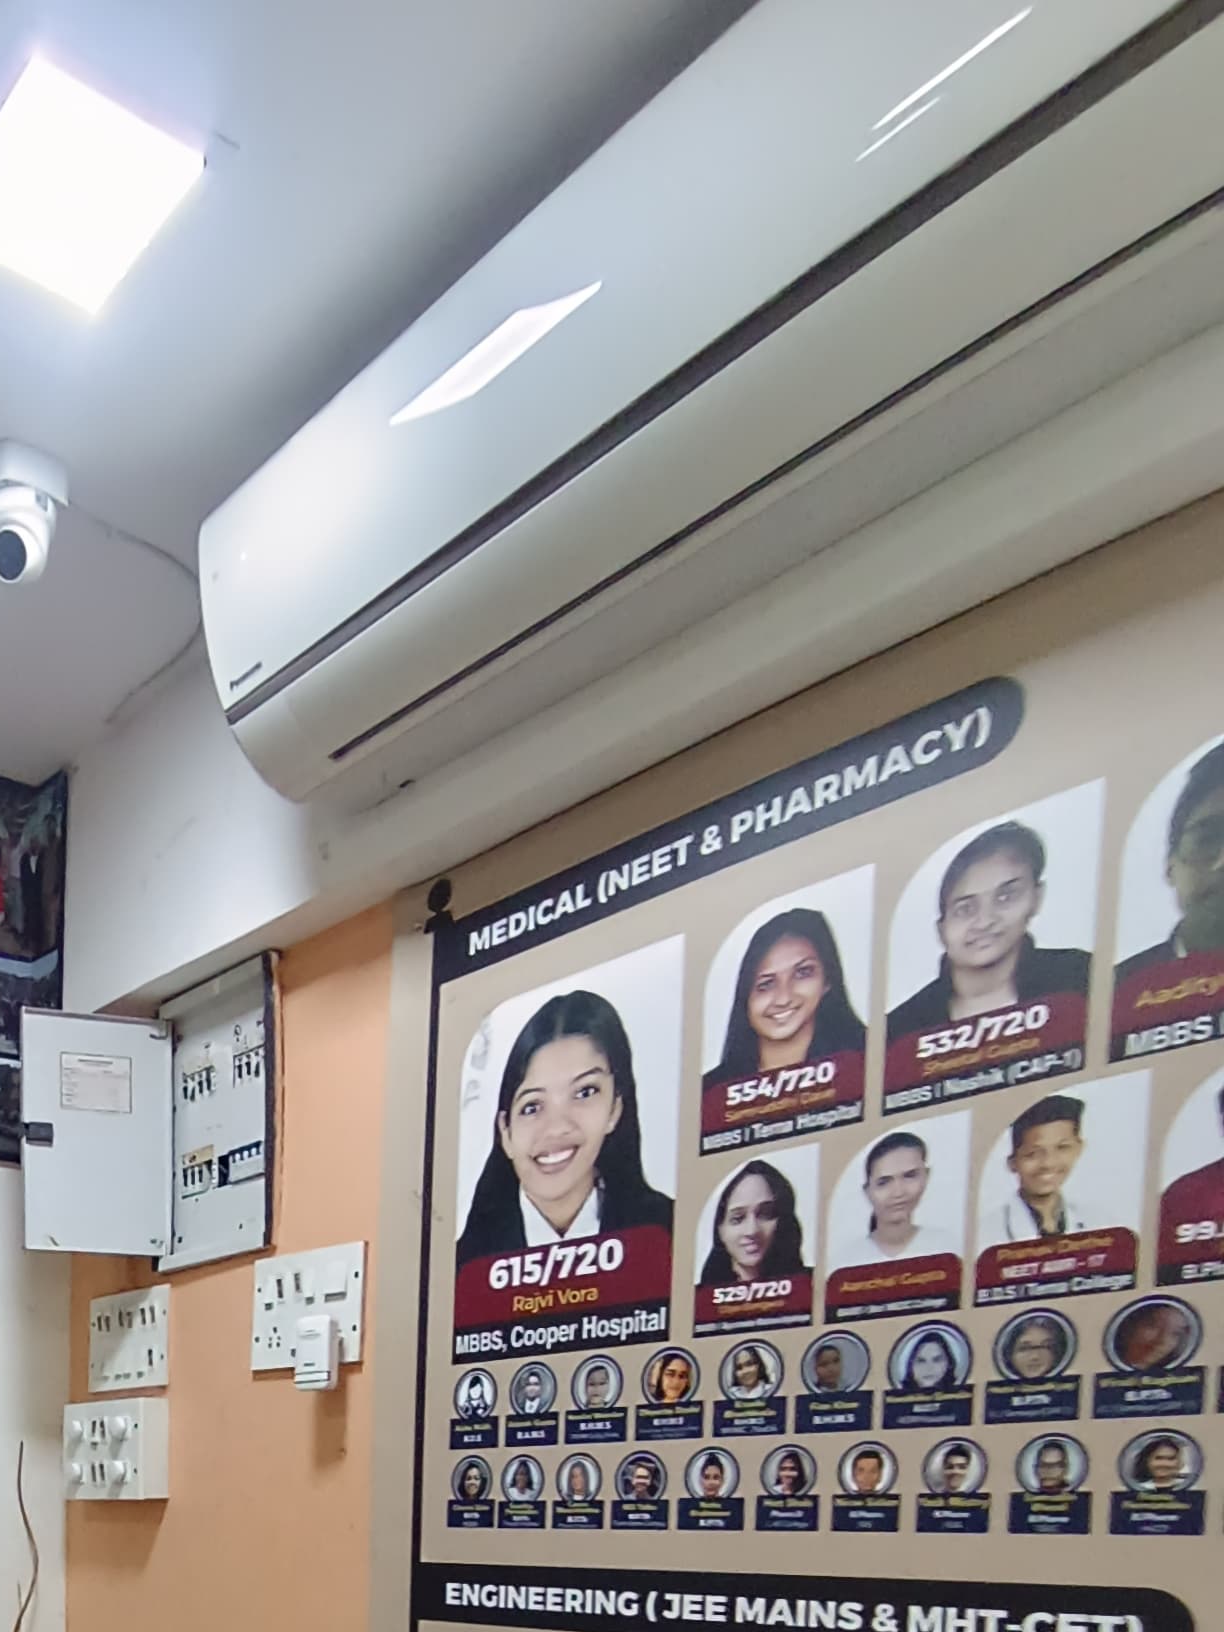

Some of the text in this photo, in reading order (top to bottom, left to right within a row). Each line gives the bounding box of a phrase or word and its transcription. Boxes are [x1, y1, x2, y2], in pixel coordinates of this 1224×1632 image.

[468, 706, 993, 956] MEDICAL (NEET & PHARMACY)
[916, 1004, 1049, 1058] 532/720
[726, 1061, 835, 1106] 554/720
[489, 1238, 624, 1290] 615/720
[513, 1287, 599, 1313] Rajvi Vora
[713, 1279, 792, 1304] 529/720
[456, 1330, 508, 1354] MBBS,
[511, 1322, 578, 1350] Cooper
[582, 1306, 667, 1341] Hospital
[445, 1582, 639, 1617] ENGINEERING
[735, 1597, 863, 1631] MAINS
[872, 1603, 898, 1632] &
